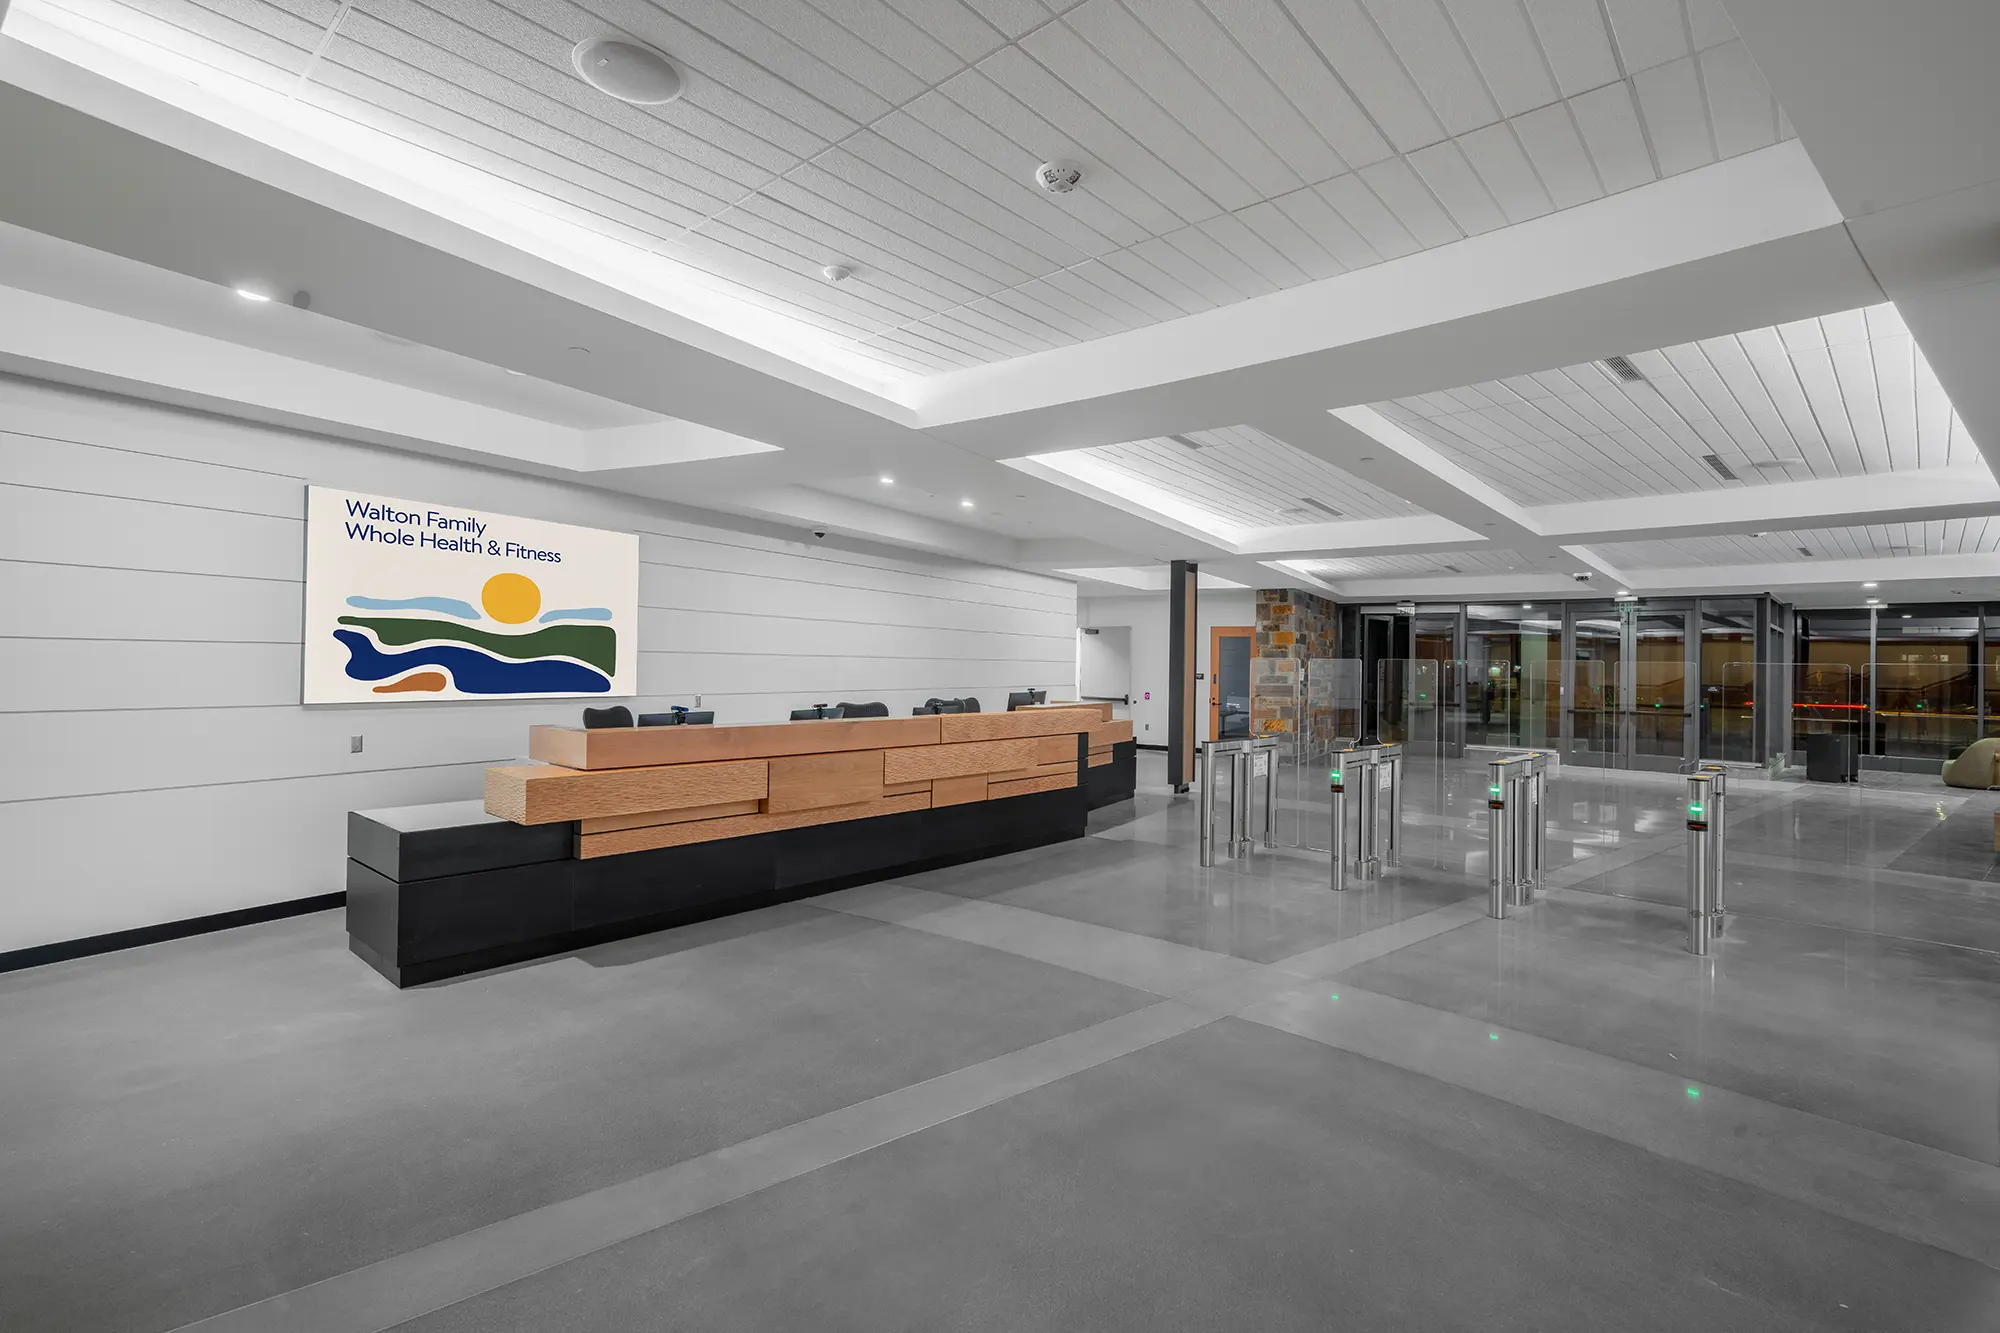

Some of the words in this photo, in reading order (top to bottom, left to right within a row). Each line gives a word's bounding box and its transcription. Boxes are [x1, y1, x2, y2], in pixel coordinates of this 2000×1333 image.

[345, 498, 421, 526] Walton
[427, 511, 487, 538] Family
[345, 521, 415, 546] Whole
[420, 532, 483, 554] Health
[487, 539, 502, 556] &
[505, 542, 562, 563] Fitness
